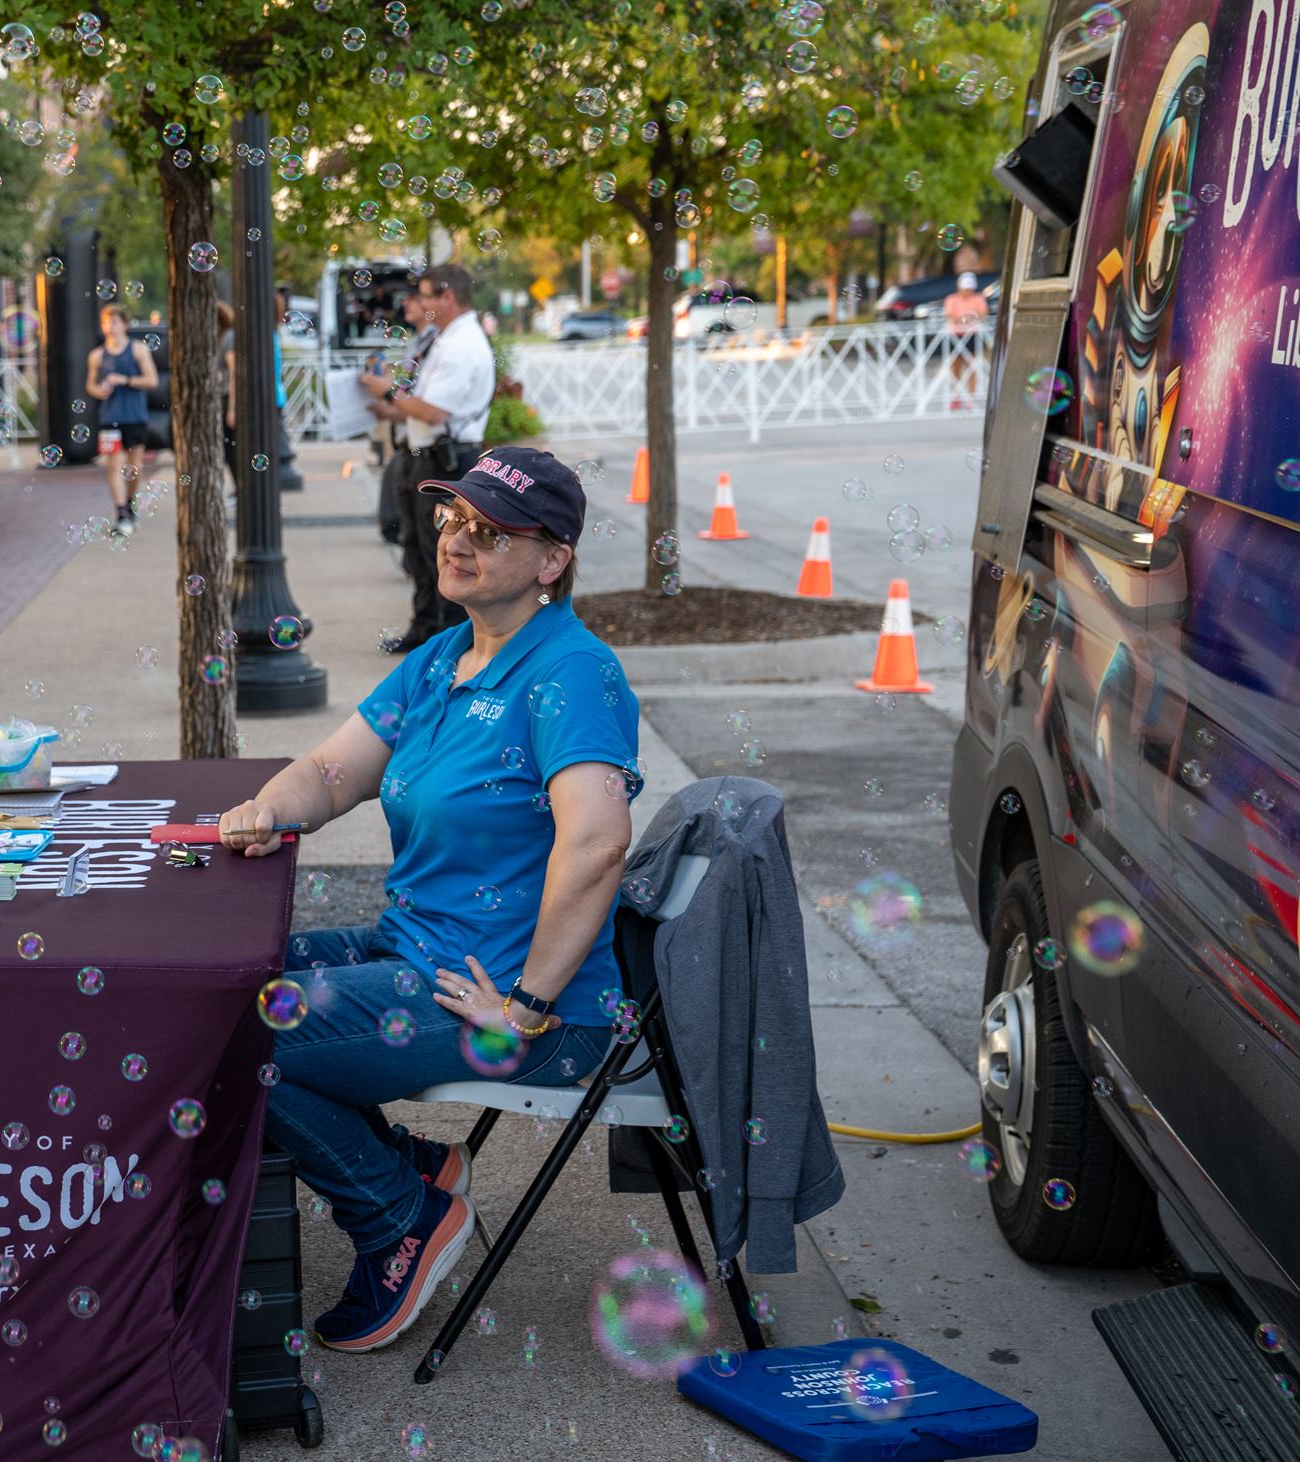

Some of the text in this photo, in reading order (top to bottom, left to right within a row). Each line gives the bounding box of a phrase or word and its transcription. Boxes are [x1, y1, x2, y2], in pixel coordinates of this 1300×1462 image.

[469, 457, 535, 494] BRARY
[466, 699, 506, 720] BURLESO
[36, 1135, 73, 1150] OF
[382, 1236, 421, 1293] HOKA
[790, 1369, 861, 1383] COUNTY
[794, 1374, 876, 1390] JOHNSON
[781, 1378, 916, 1398] REACH ACROSS
